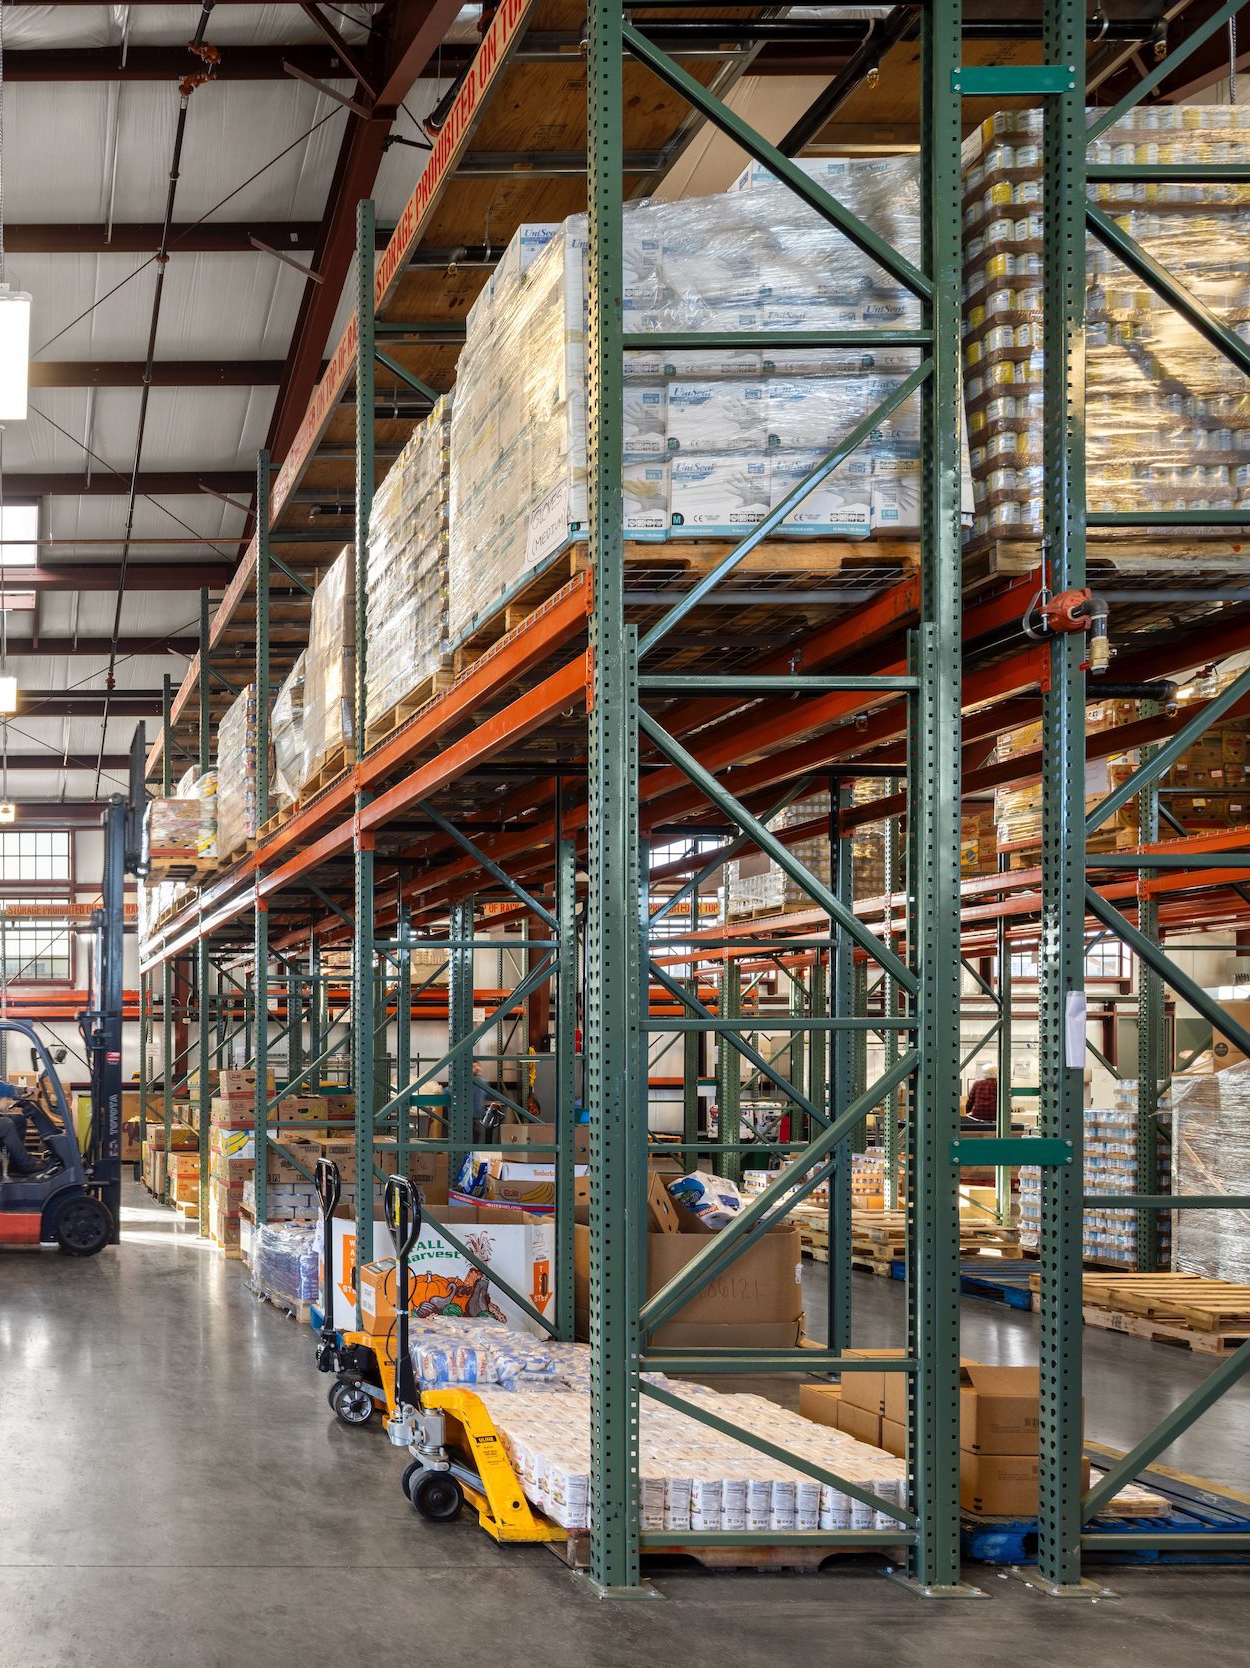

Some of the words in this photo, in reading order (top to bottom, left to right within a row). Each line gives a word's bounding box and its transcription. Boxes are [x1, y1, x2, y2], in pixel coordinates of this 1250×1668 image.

[375, 204, 414, 299] STORAGE
[415, 70, 475, 220] PROHIBITED
[479, 26, 497, 89] ON
[8, 904, 42, 915] STORAGE
[43, 904, 85, 915] PROHIBITED
[489, 903, 500, 913] OF
[705, 904, 718, 913] TOP
[108, 1093, 119, 1135] TOYOTA
[407, 1250, 462, 1264] arvest
